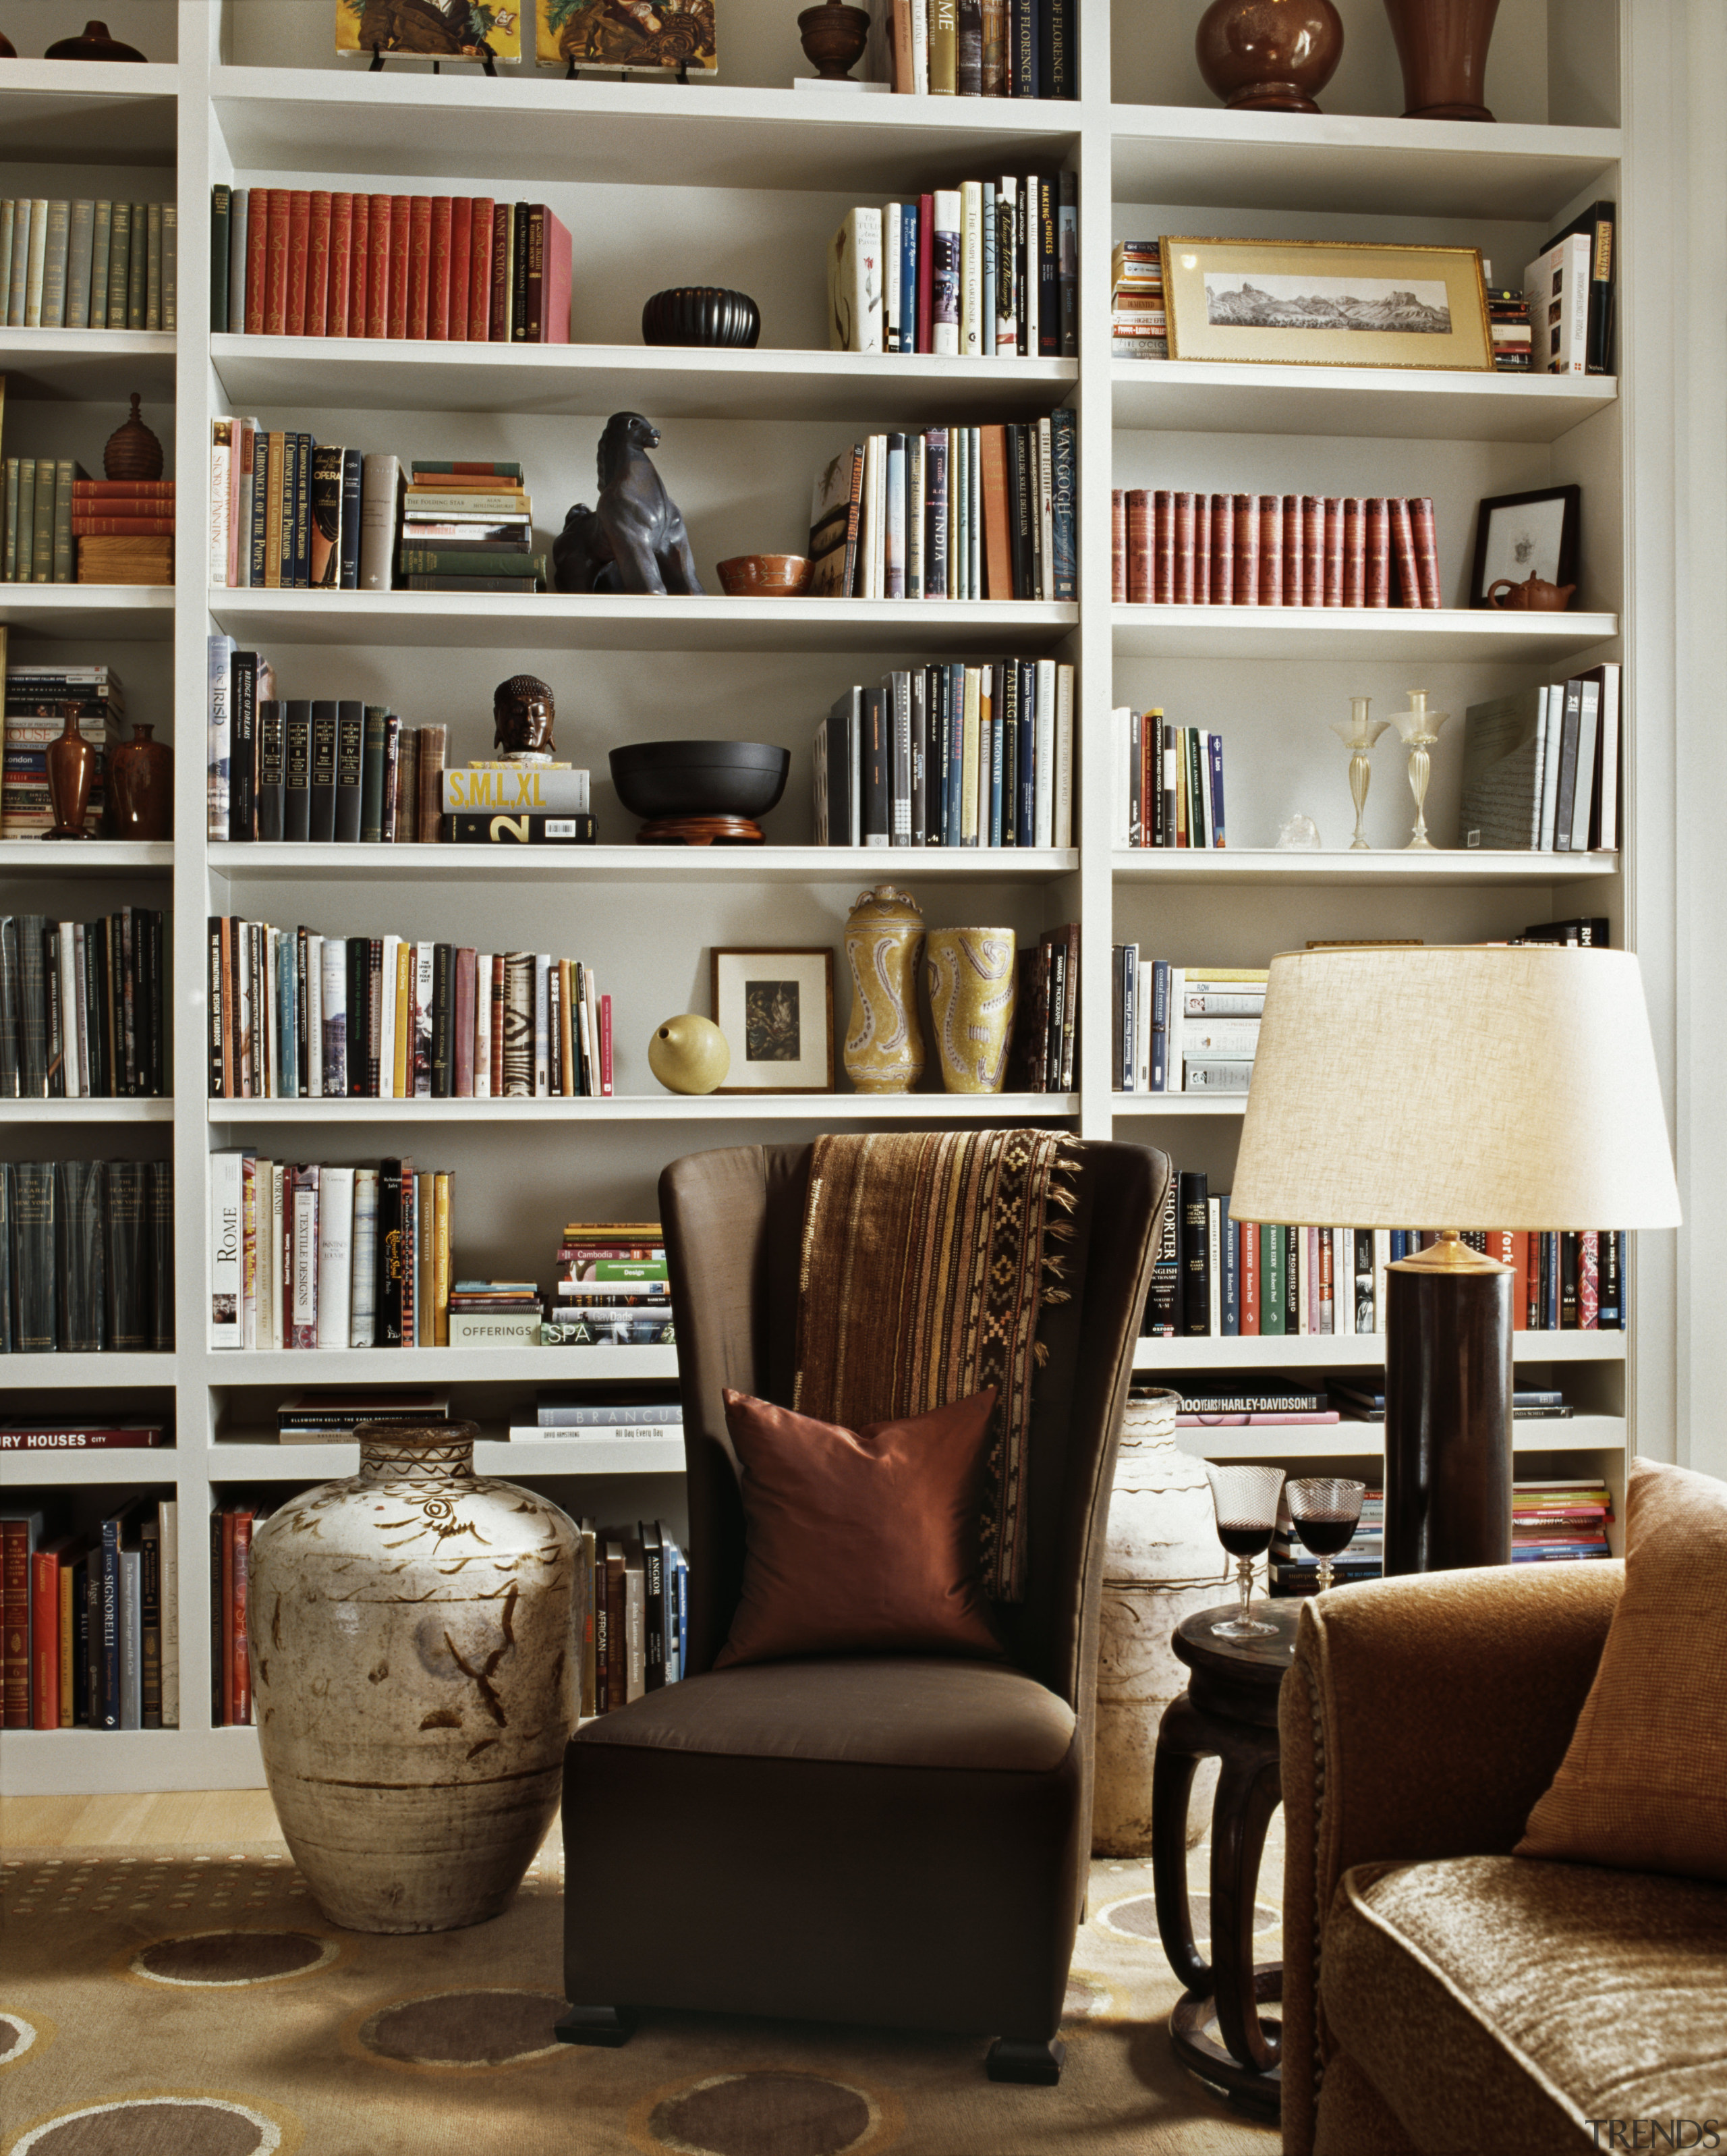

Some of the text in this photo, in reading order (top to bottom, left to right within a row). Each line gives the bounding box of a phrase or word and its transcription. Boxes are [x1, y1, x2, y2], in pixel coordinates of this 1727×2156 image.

[1020, 16, 1031, 82] FLORENCE
[1052, 17, 1064, 83] FLORENCE
[1042, 185, 1050, 219] MAKING
[495, 208, 505, 284] ANNE SEXTON
[969, 211, 977, 325] THE COMPLETE GARDENER
[273, 446, 281, 483] CHRONICLE
[314, 471, 341, 480] OPERA
[1042, 433, 1051, 495] SONIA DELAUNAY
[1056, 426, 1072, 515] VAN GOGH
[212, 455, 223, 549] STORY PAINTING
[254, 444, 268, 571] CHRONICLE OF THE POPES
[272, 484, 279, 493] OF
[283, 444, 296, 560] CHRONICLE OF THE PHARAOHS
[298, 444, 308, 559] CHRONICLE THE ROMAN EMPERORS
[420, 499, 449, 507] FOLDING
[847, 457, 863, 541] PERSISTENT VESTIGES
[271, 507, 279, 536] CHINESE
[934, 515, 945, 561] INDIA
[270, 537, 279, 572] EMPERORS
[1007, 669, 1018, 726] FABERGÉ
[1023, 667, 1031, 696] Johannes
[244, 700, 251, 709] OF
[955, 677, 963, 760] SACRED VISIONS
[389, 734, 397, 761] Darger
[982, 727, 990, 765] MATISSE
[993, 725, 1002, 783] FRAGONARD
[449, 772, 547, 810] S,M,L,XL
[1069, 934, 1078, 974] designing
[212, 933, 221, 1046] THE INTERNATIONAL DESIGN YEARBOOK
[399, 963, 407, 990] Guo-Qiang
[1067, 994, 1076, 1020] plants
[254, 1032, 259, 1041] IN
[1125, 1036, 1133, 1064] Historical
[217, 1207, 237, 1264] ROME
[246, 1179, 254, 1296] Bloom Book Li Edelkoort
[1164, 1191, 1176, 1259] SHORTER
[300, 1211, 308, 1306] TEXTILE DESIGNS
[438, 1213, 447, 1308] 20th Century Pattern Design
[577, 1250, 613, 1259] Cambodia
[462, 1326, 532, 1336] OFFERINGS
[548, 1325, 591, 1343] SPA
[576, 1409, 683, 1424] BRANCUS
[1180, 1397, 1309, 1412] 100 YEARS HARLEY-DAVIDSON
[27, 1434, 87, 1447] HOUSES
[544, 1431, 580, 1439] DAVID ARMSTRONG
[615, 1428, 664, 1438] All Day Every Day
[87, 1579, 100, 1605] Atget
[652, 1556, 660, 1596] ANGKOR
[105, 1574, 113, 1647] SIGNORELLI
[598, 1609, 606, 1652] AFRICAN
